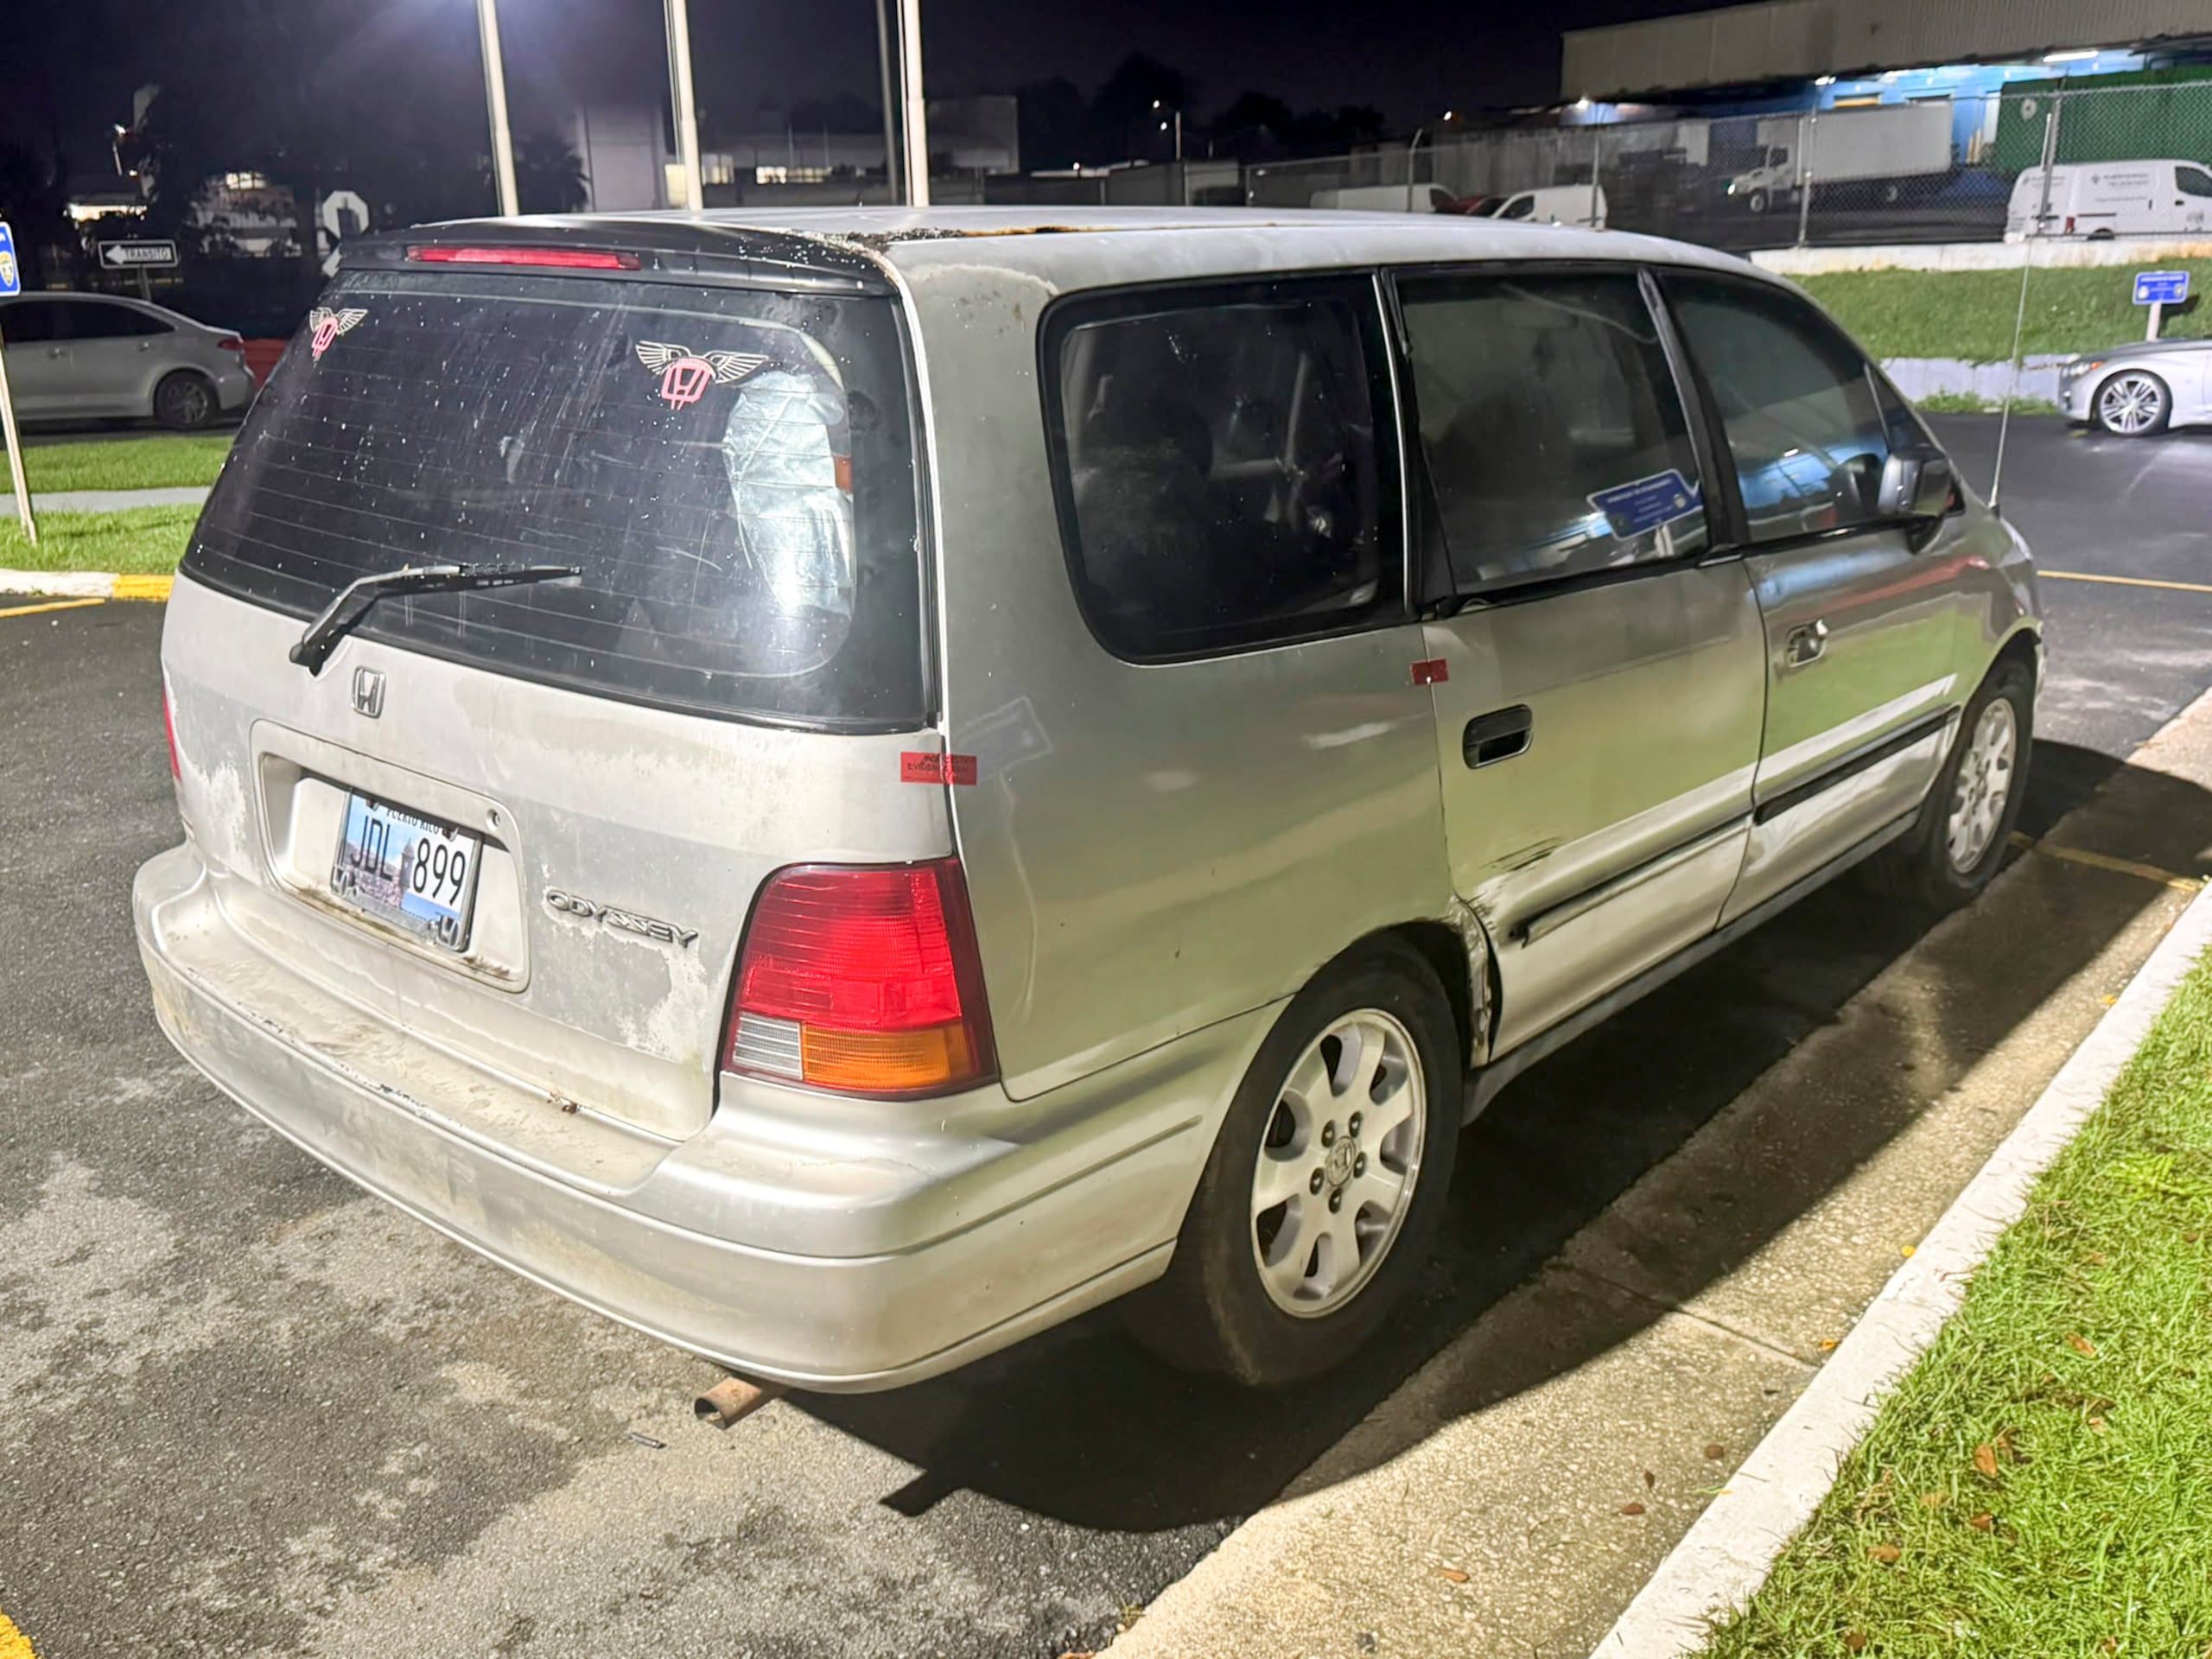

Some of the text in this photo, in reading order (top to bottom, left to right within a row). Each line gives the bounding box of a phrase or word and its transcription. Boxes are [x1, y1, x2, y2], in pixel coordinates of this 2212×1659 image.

[350, 815, 466, 906] JDL 899
[546, 889, 699, 949] ODYSSEY
